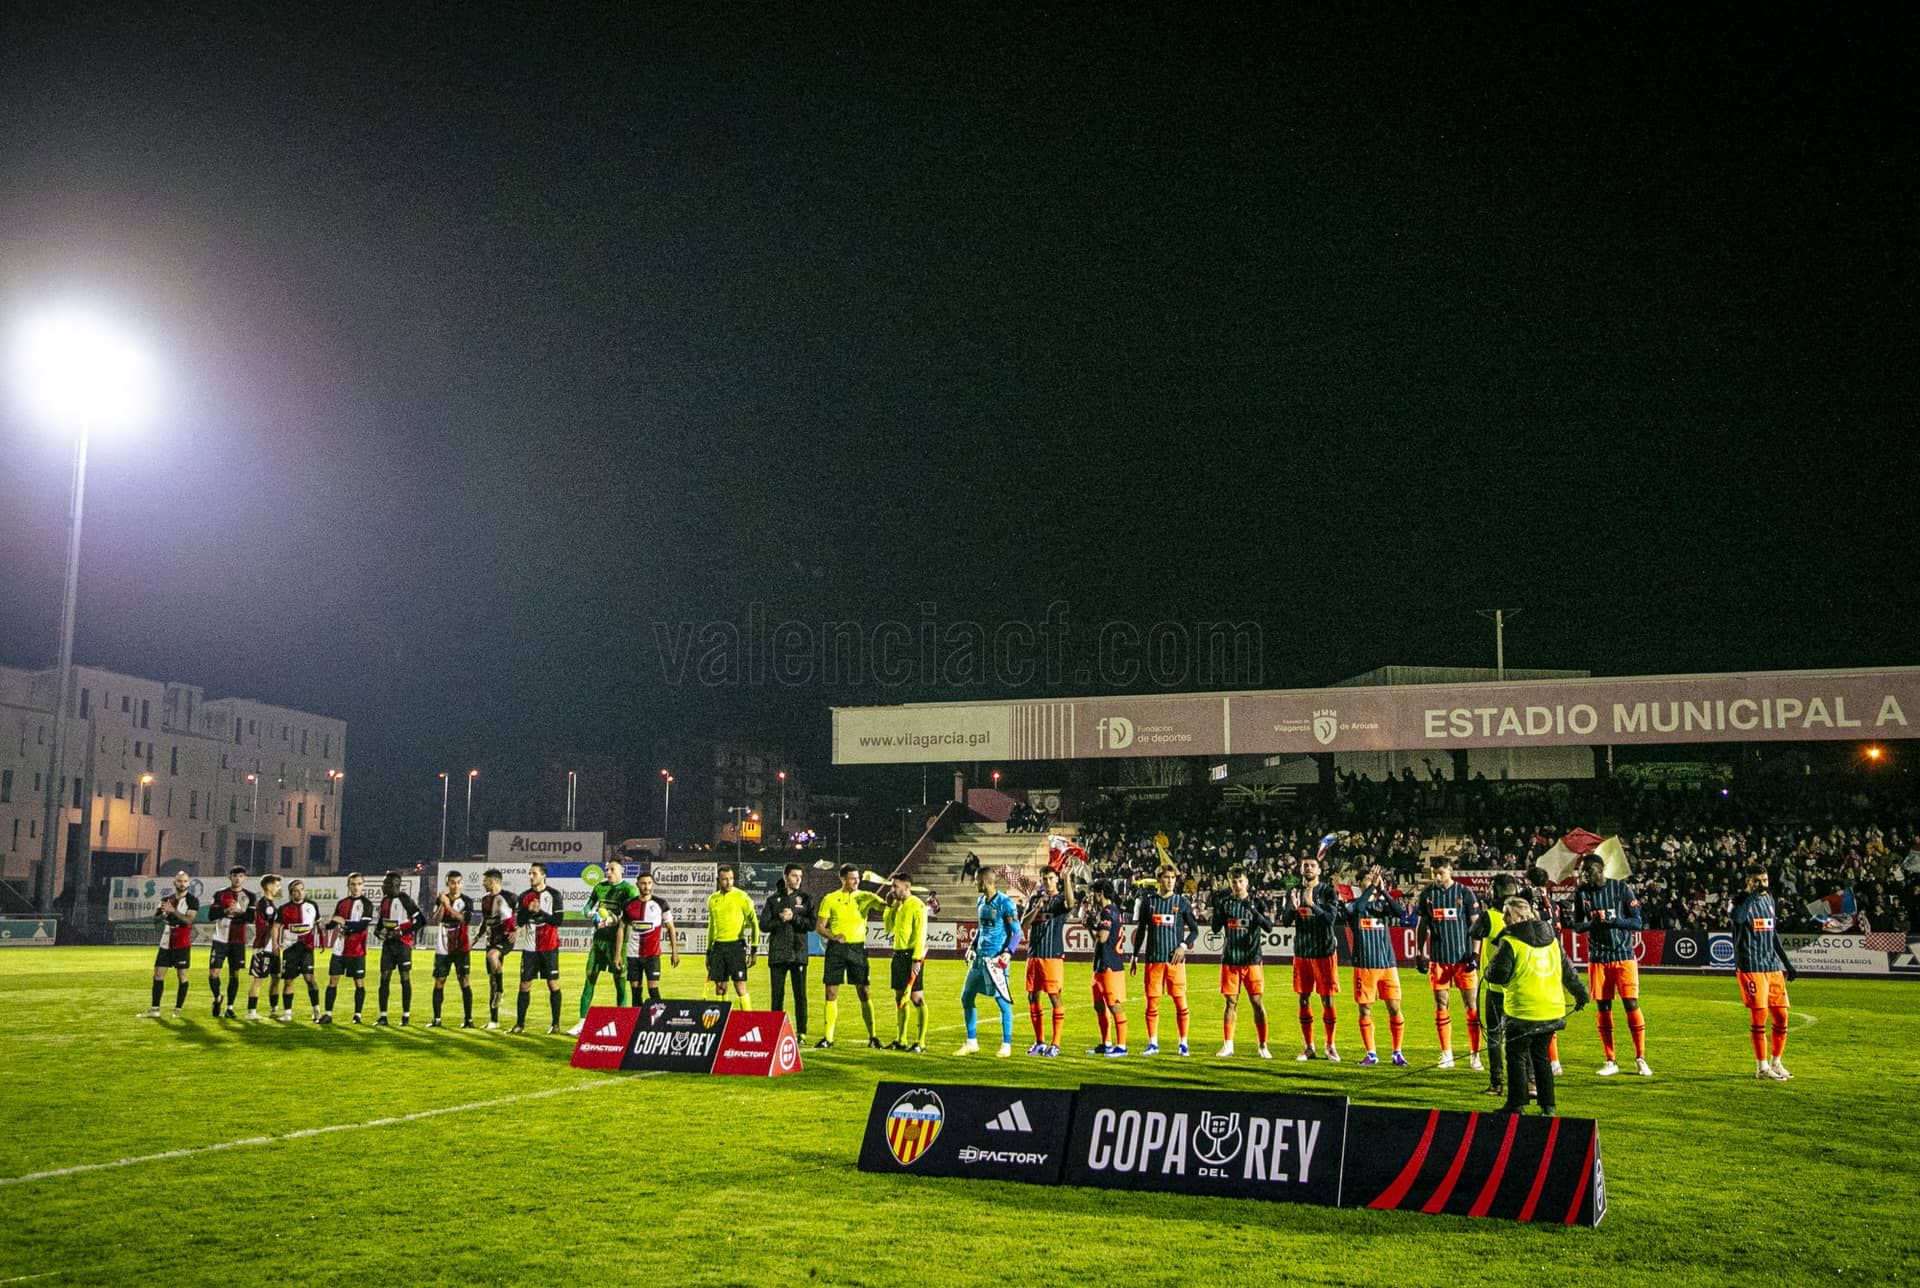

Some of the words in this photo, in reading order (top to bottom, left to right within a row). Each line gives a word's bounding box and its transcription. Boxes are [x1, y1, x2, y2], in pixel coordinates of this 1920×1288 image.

[1423, 704, 1599, 738] ESTADIO
[1613, 697, 1861, 733] MUNICIPAL
[1875, 695, 1907, 727] A
[1137, 735, 1149, 743] de
[1151, 734, 1192, 744] deportes
[510, 835, 583, 854] Alcampo
[655, 872, 688, 882] Jacinto
[691, 871, 715, 882] Vidal
[1782, 938, 1853, 949] ARRASCO
[1806, 957, 1872, 965] CONSIGNATARIOS
[634, 1031, 672, 1055] COPA
[686, 1032, 717, 1057] REY
[1087, 1108, 1189, 1176] COPA
[1198, 1167, 1229, 1178] DEL
[1243, 1117, 1321, 1184] REY
